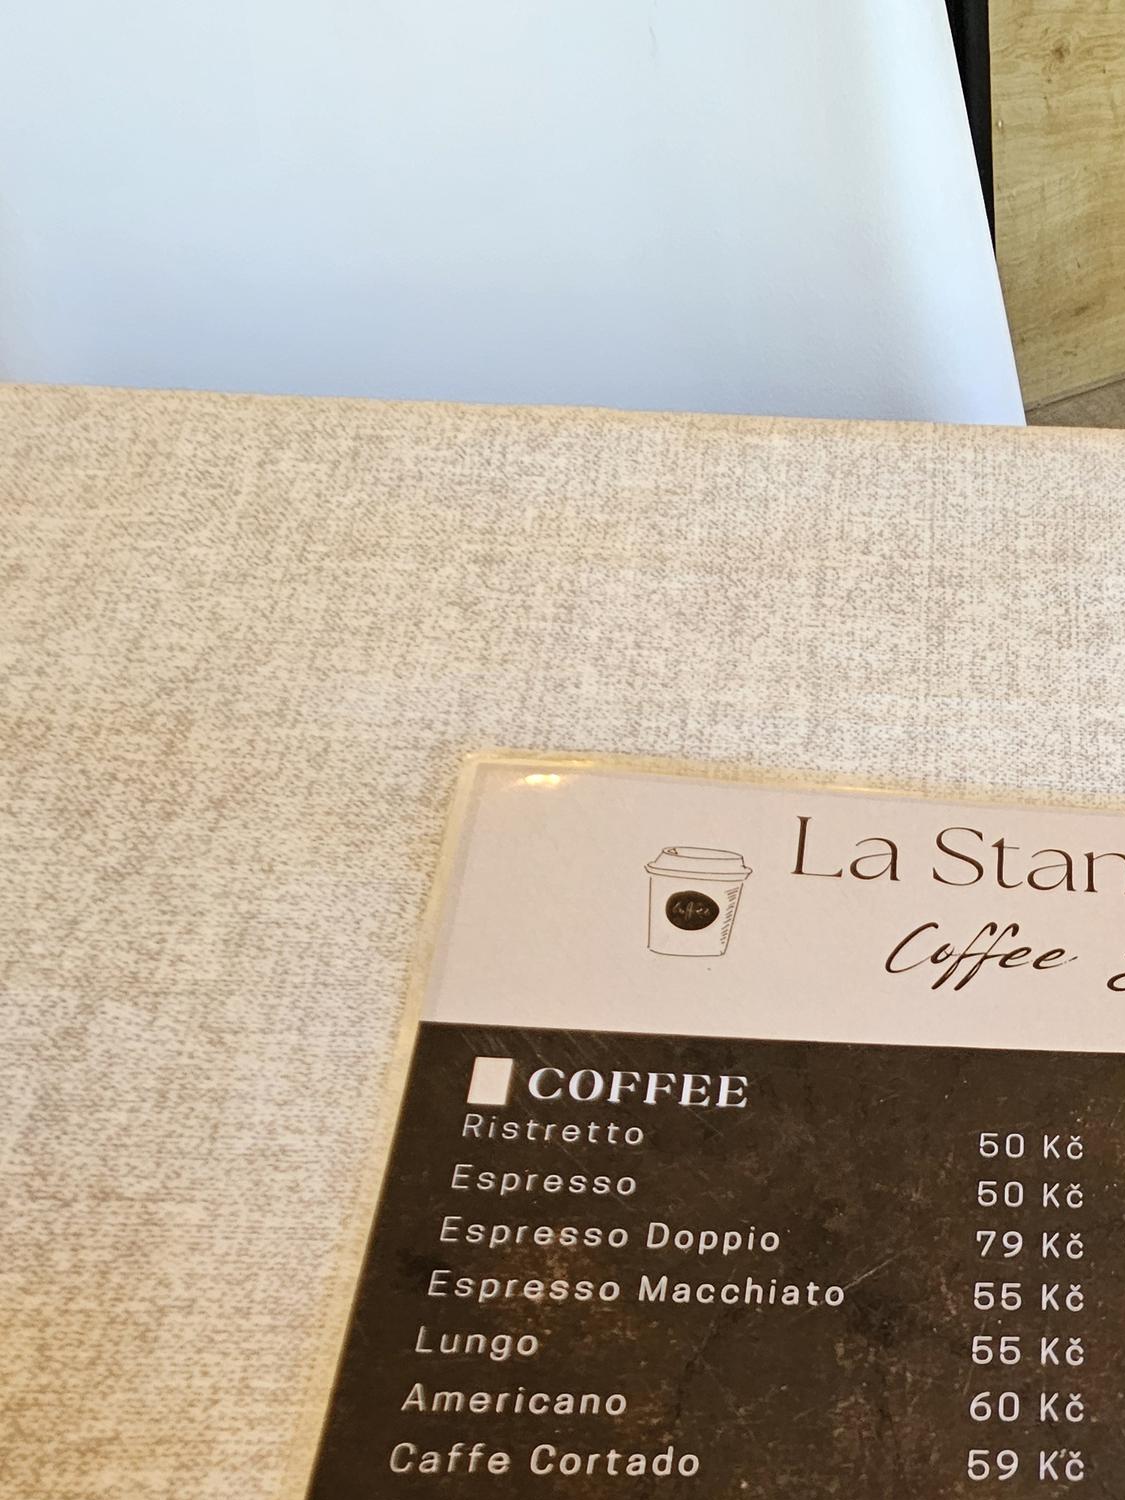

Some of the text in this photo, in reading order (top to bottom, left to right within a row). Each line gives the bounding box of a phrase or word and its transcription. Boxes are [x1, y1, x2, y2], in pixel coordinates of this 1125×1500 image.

[791, 815, 900, 882] La
[884, 921, 1078, 992] Coffee
[528, 1067, 748, 1108] COFFEE
[462, 1113, 644, 1145] Ristretto
[979, 1132, 1083, 1160] 50 Kč
[451, 1163, 636, 1196] Espresso
[977, 1180, 1083, 1209] 50 Kč
[439, 1215, 780, 1256] Espresso Doppio
[976, 1230, 1084, 1260] 79 Kč
[427, 1269, 845, 1307] Espresso Macchiato
[973, 1282, 1084, 1312] 55 Kč
[414, 1325, 539, 1362] Lungo
[971, 1335, 1084, 1366] 55 Kč
[400, 1382, 627, 1416] Americano
[969, 1391, 1085, 1423] 60 Kč
[389, 1442, 700, 1477] Caffe Cortado
[967, 1448, 1085, 1482] 59 Kč
